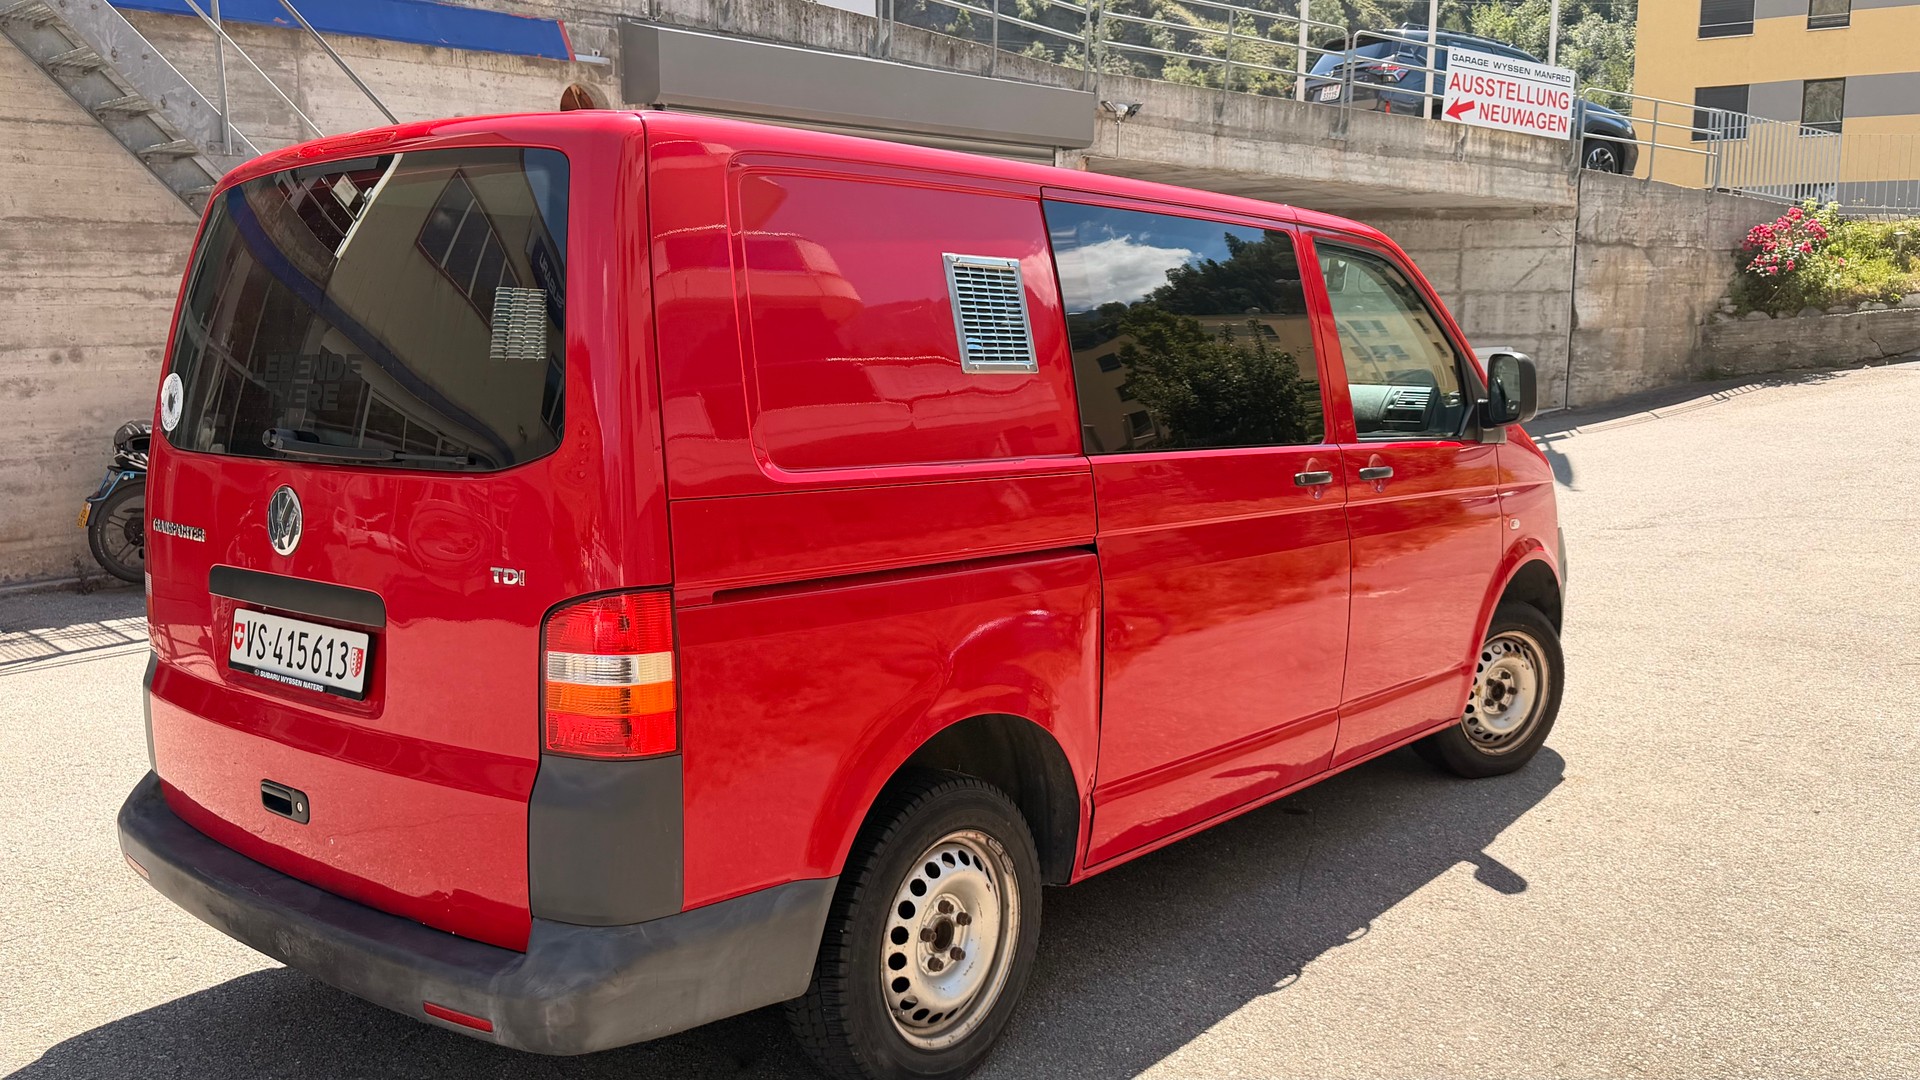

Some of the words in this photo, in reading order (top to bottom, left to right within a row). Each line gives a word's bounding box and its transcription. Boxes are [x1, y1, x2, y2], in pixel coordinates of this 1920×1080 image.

[1452, 53, 1489, 68] GARAGE
[1493, 61, 1531, 76] WYSSEN
[1534, 69, 1571, 83] MANFRED
[1448, 72, 1570, 110] AUSSTELLUNG
[1478, 102, 1568, 133] NEUWAGEN
[490, 566, 525, 587] TDI
[260, 670, 280, 681] SUBARU
